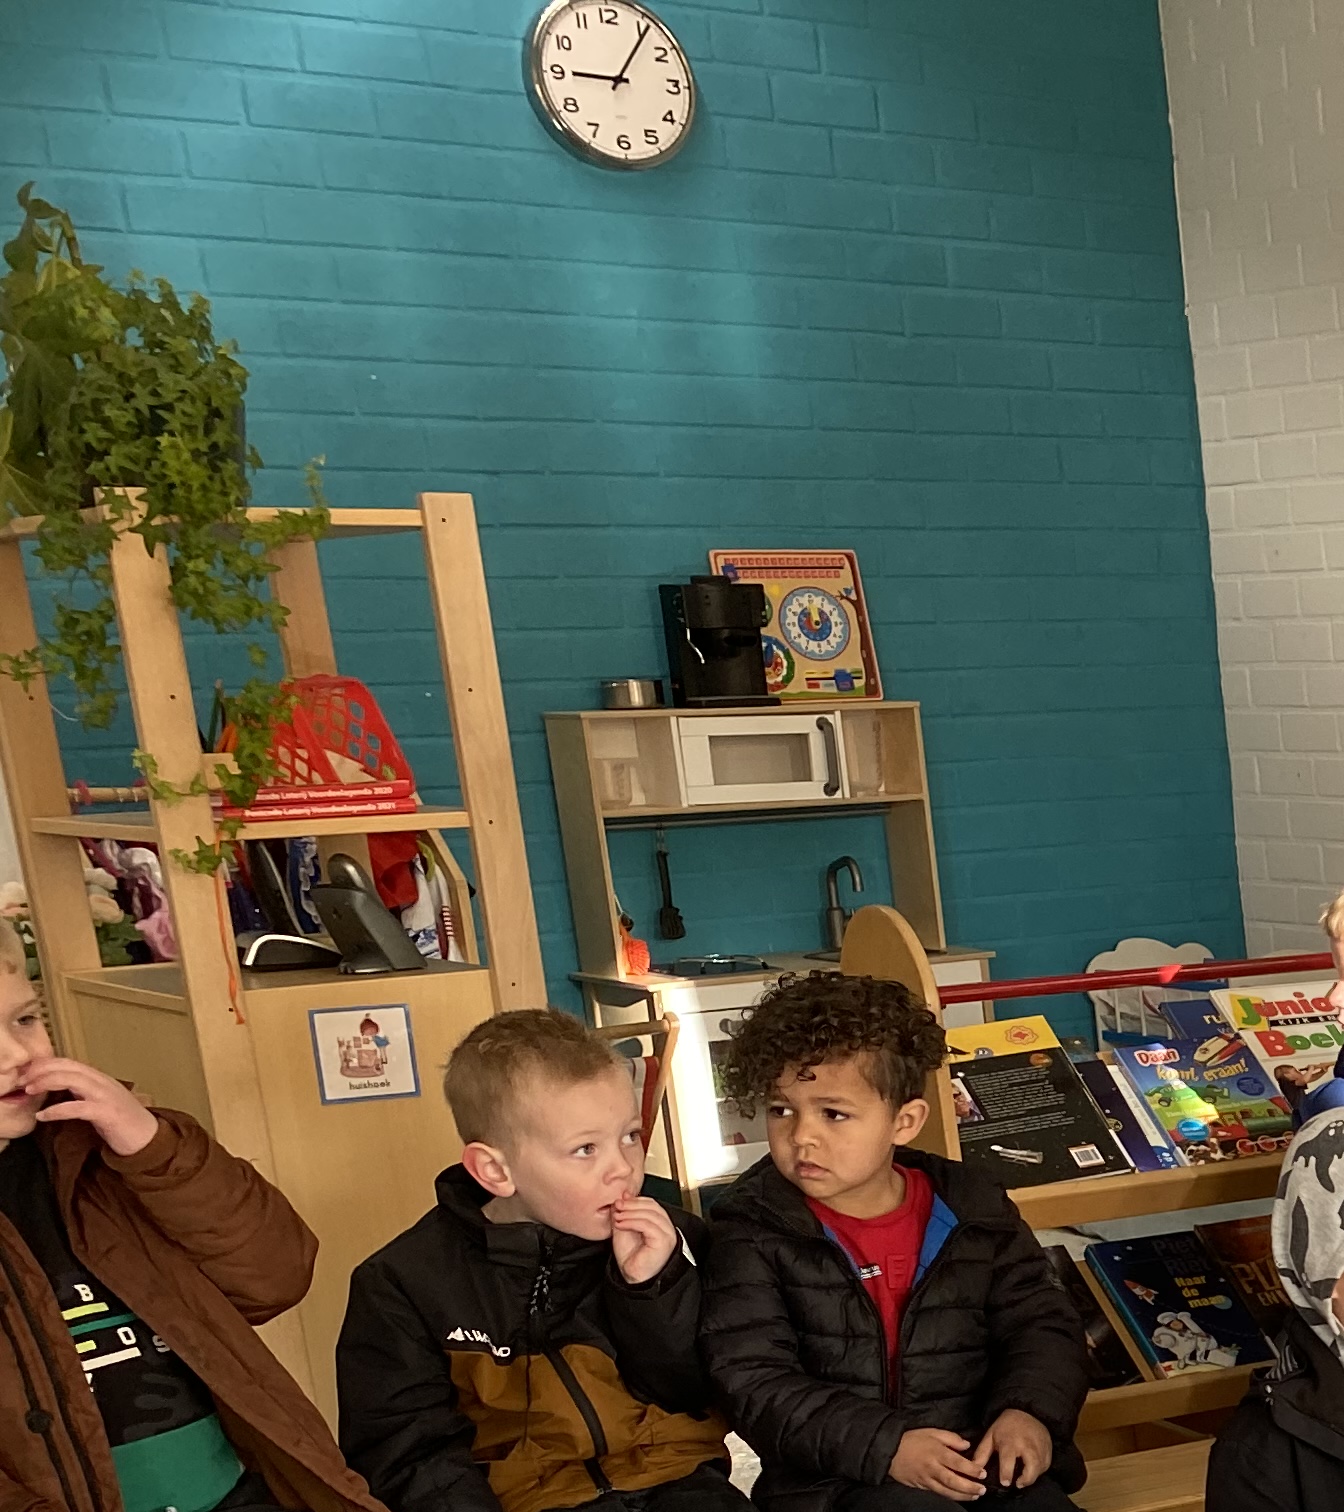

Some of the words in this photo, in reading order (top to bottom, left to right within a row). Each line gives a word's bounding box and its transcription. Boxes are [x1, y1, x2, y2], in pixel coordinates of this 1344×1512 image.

[576, 12, 588, 29] 11
[598, 7, 619, 26] 12
[556, 34, 572, 51] 10
[653, 47, 669, 63] 2
[550, 64, 565, 80] 9
[666, 79, 681, 95] 3
[563, 97, 580, 113] 8
[662, 110, 676, 125] 4
[587, 121, 600, 138] 7
[643, 129, 659, 145] 5
[616, 135, 631, 150] 6
[1237, 991, 1336, 1026] Junio
[1137, 1050, 1177, 1065] Daan
[348, 1079, 391, 1090] huishoek
[1174, 1275, 1206, 1287] Naar
[74, 1284, 94, 1301] B
[1182, 1286, 1199, 1298] de
[1188, 1295, 1226, 1308] maan
